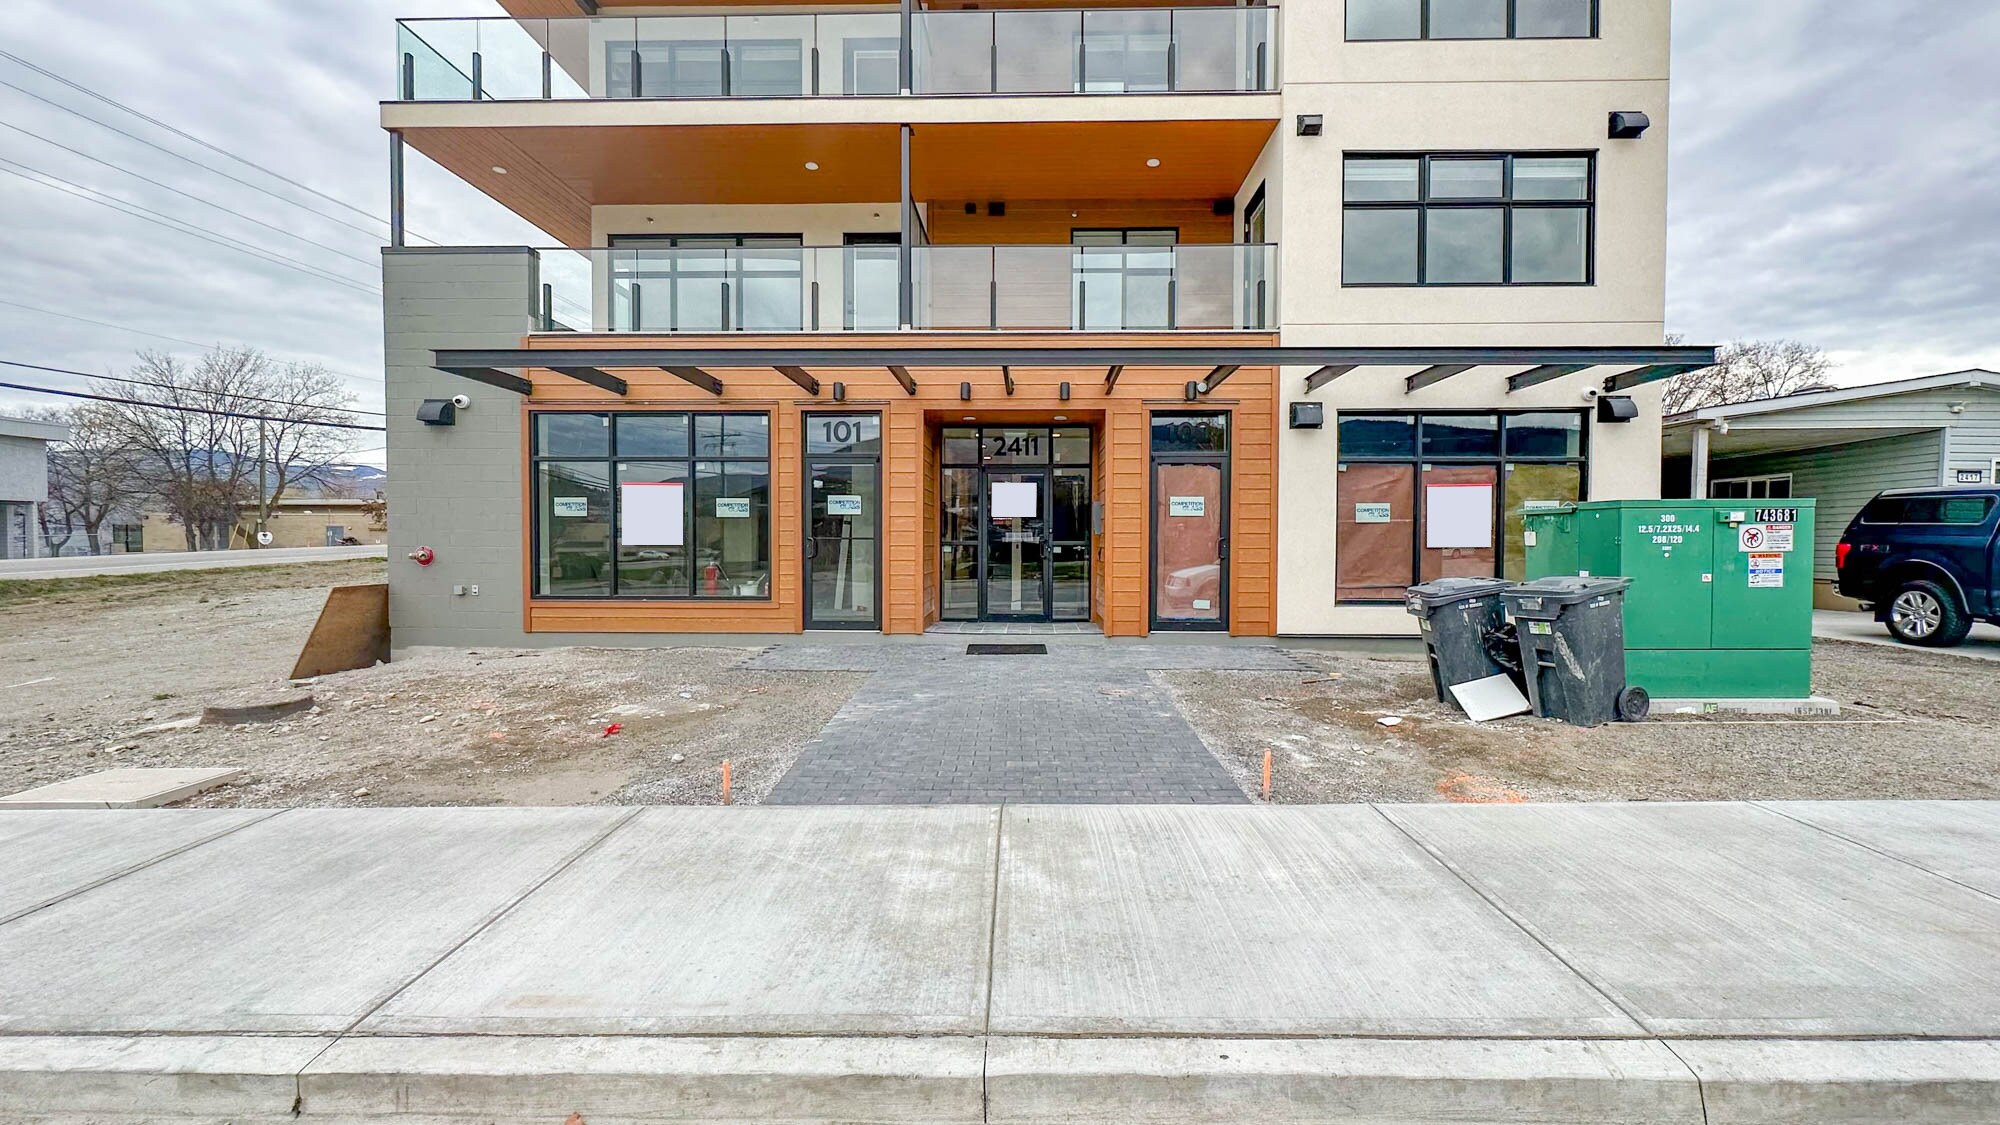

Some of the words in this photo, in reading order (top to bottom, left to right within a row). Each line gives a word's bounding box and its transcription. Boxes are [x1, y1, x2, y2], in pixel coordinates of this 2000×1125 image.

[822, 420, 862, 443] 101
[992, 436, 1039, 457] 2411
[1960, 473, 1978, 481] 2417
[1660, 514, 1676, 523] 300
[1755, 509, 1797, 522] 743681
[1703, 702, 1718, 714] AE
